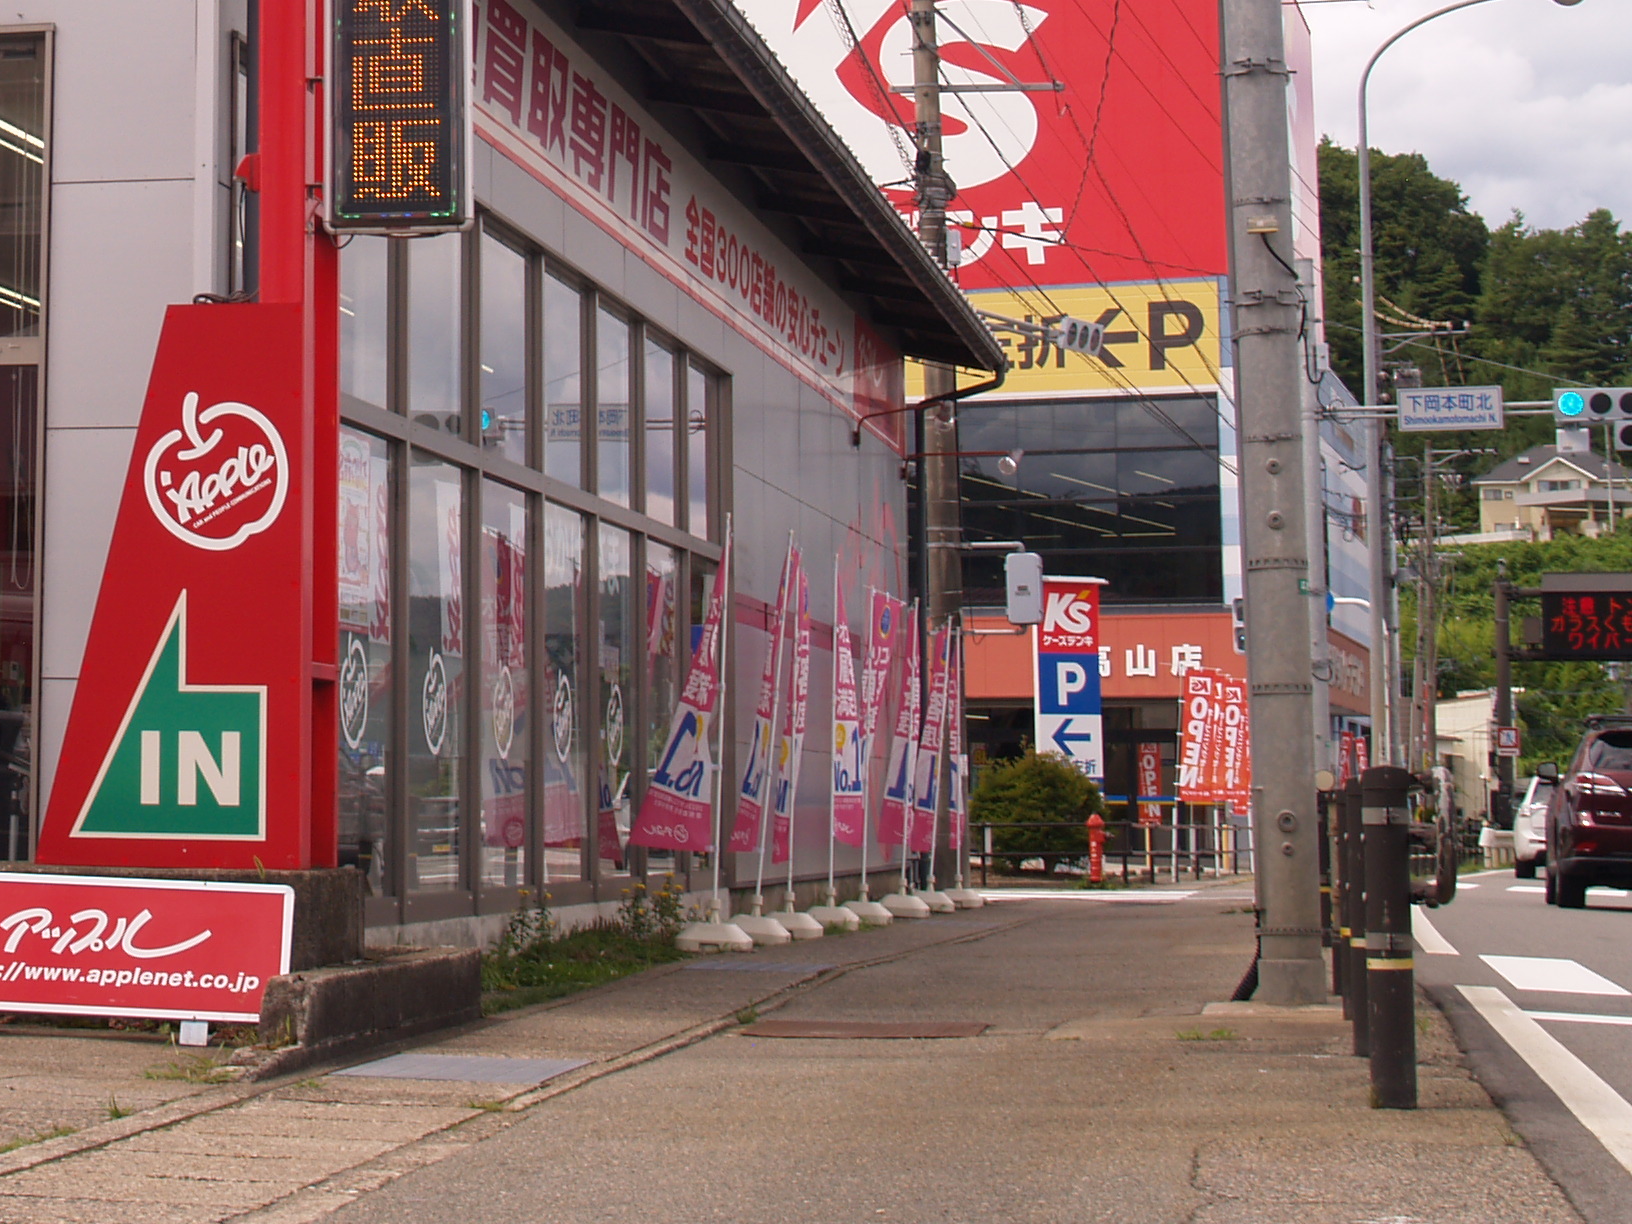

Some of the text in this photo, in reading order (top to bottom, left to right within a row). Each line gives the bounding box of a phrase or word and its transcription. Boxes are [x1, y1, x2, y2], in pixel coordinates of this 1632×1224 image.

[1407, 392, 1493, 413] 下岡本町北
[1043, 634, 1094, 648] ケーズデンキ
[1056, 661, 1087, 706] P
[140, 729, 241, 807] IN
